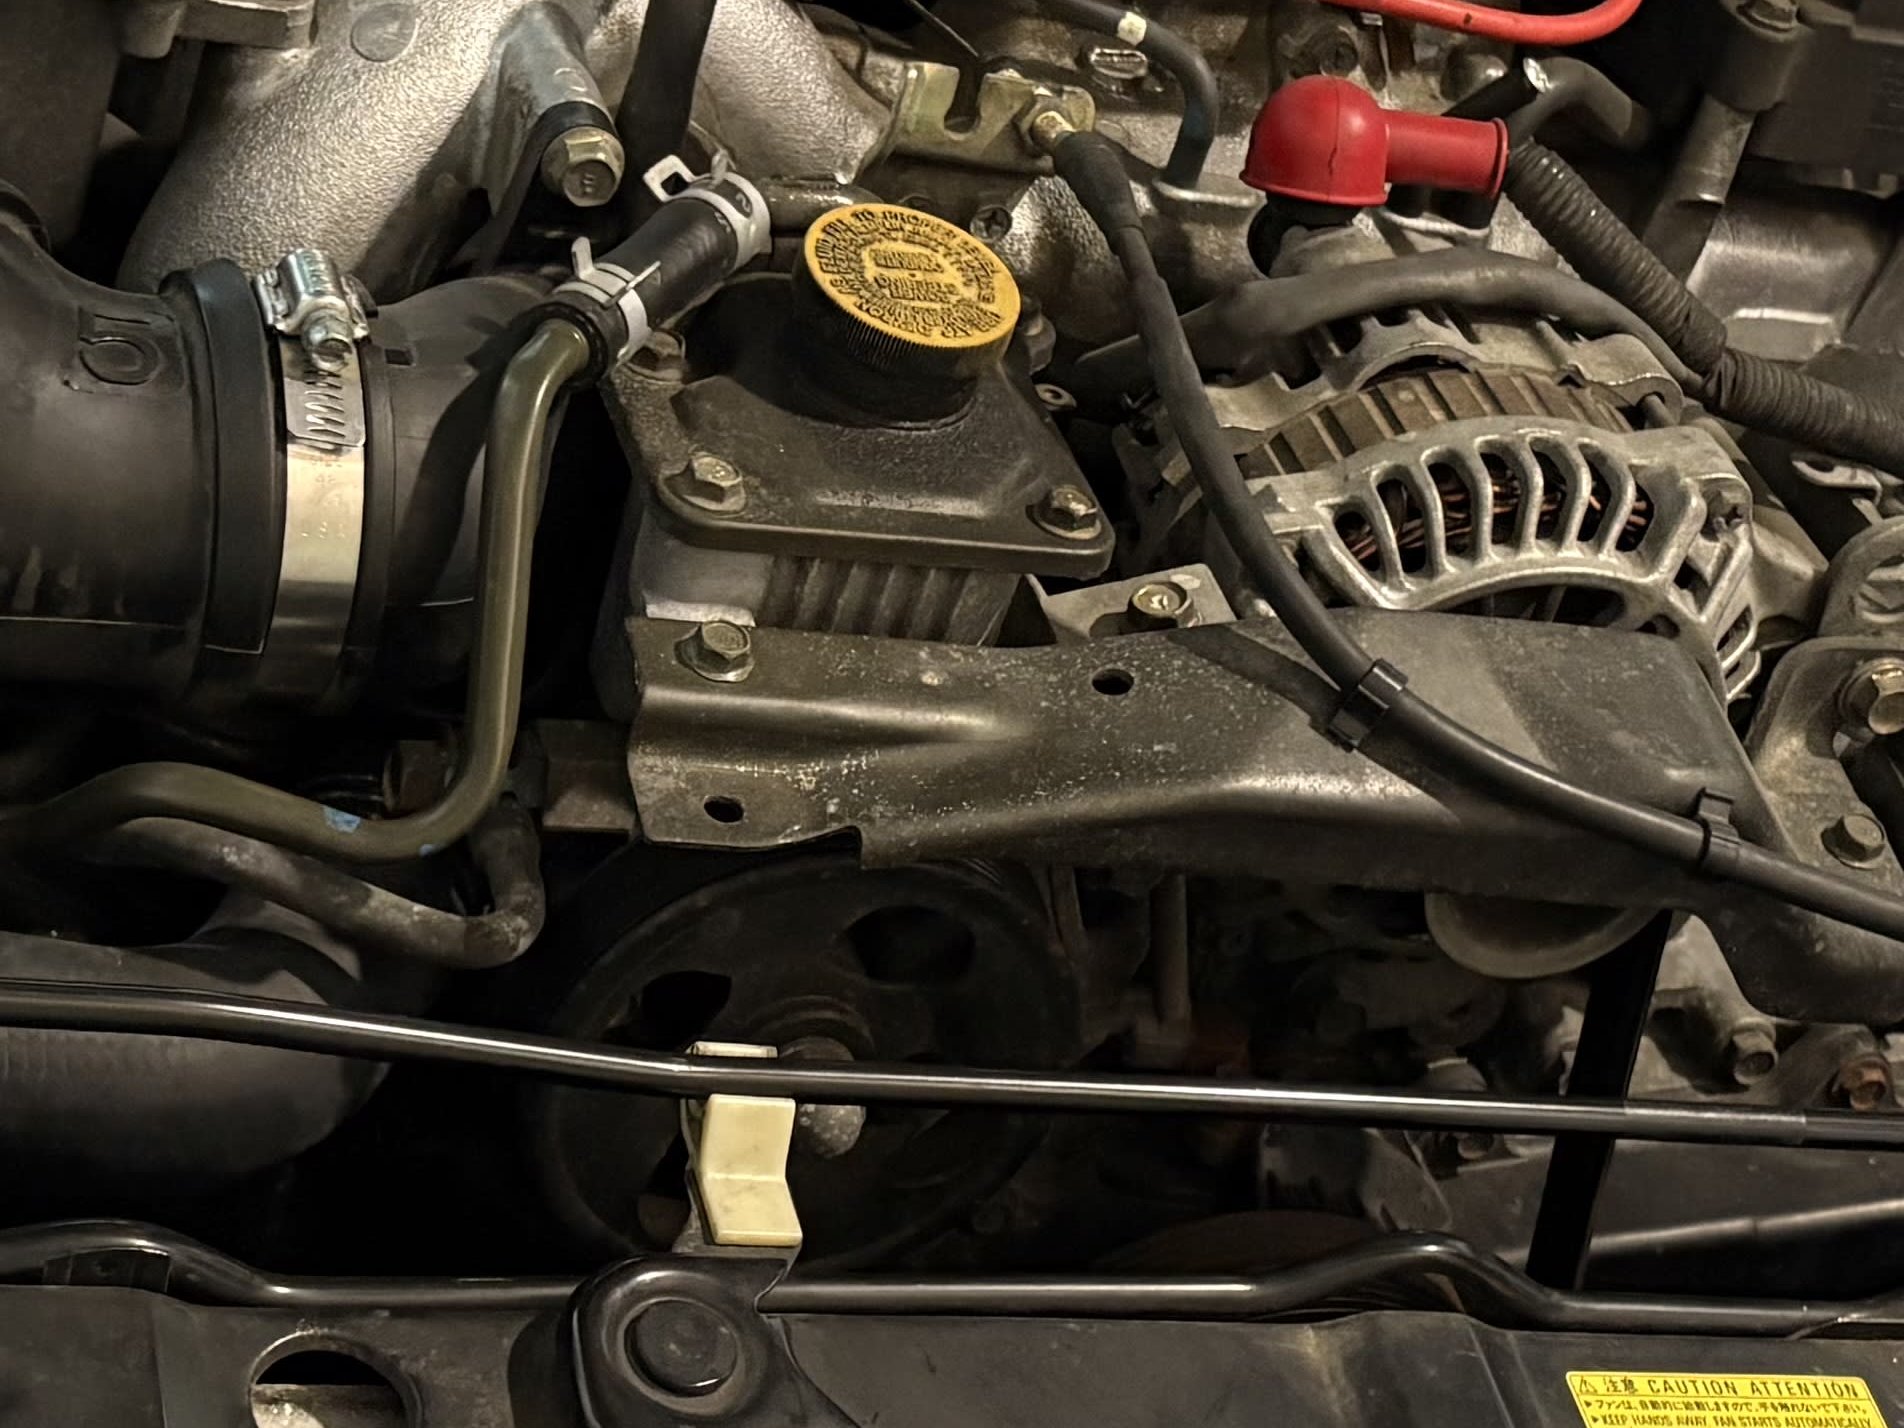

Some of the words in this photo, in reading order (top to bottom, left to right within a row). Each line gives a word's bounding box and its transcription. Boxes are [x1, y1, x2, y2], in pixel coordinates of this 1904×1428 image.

[1647, 1379, 1738, 1395] CAUTION
[1750, 1380, 1859, 1398] ATTENTION
[1738, 1417, 1781, 1428] STARTS
